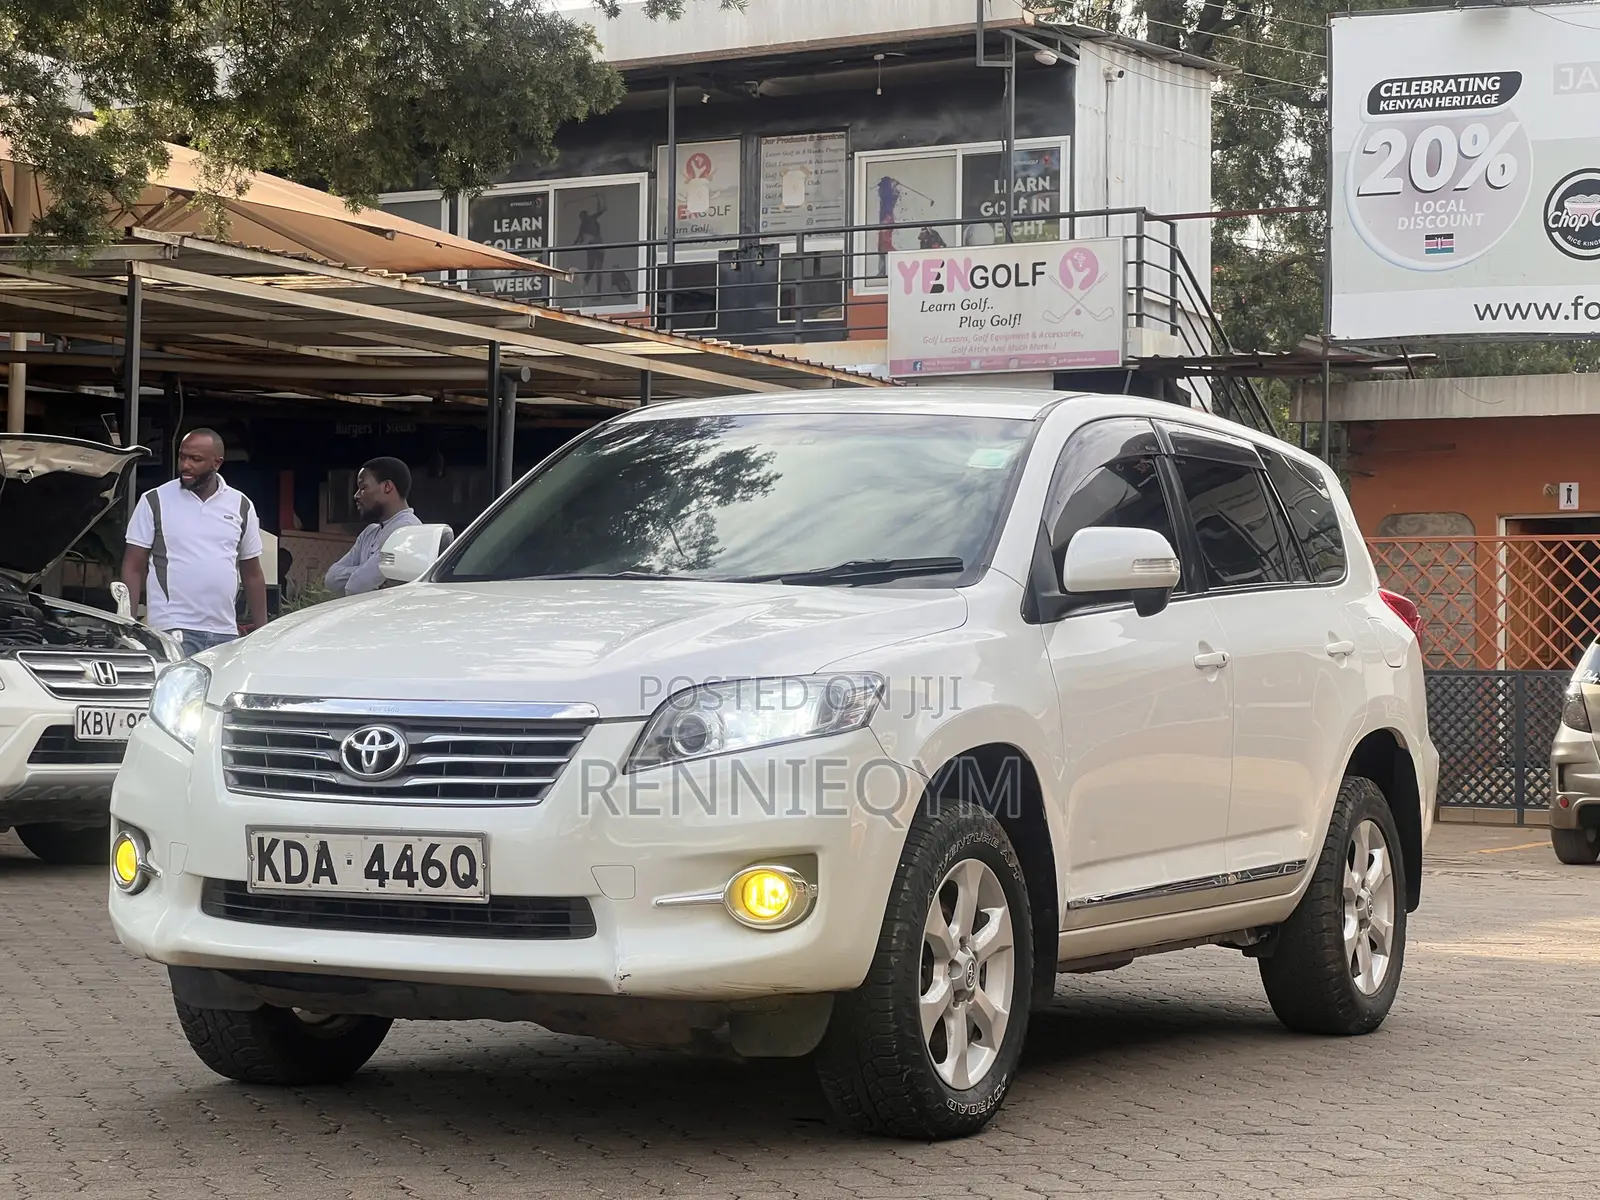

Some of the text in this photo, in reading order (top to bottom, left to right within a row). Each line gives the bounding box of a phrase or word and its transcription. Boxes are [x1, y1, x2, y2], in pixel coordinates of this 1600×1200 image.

[1379, 76, 1501, 98] CELEBRATING
[1379, 94, 1499, 111] KENYAN HERITAGE
[1356, 121, 1521, 197] 20%
[980, 197, 1050, 217] GOF IN
[1414, 199, 1467, 214] LOCAL
[493, 216, 542, 233] LEARN
[1397, 213, 1485, 230] DISCOUNT
[1548, 209, 1589, 232] Chop
[527, 236, 542, 249] IN
[1566, 234, 1582, 246] RICE
[897, 256, 1047, 295] YENGOLF
[493, 276, 542, 293] WEEKS
[920, 297, 994, 313] Learn Golf..
[959, 313, 1022, 330] Play Golf!
[922, 335, 939, 346] Golf
[973, 333, 989, 343] Golf
[990, 331, 1029, 342] Equipment
[1031, 331, 1037, 339] &
[951, 345, 967, 355] Golf
[81, 710, 116, 736] KBV
[257, 836, 479, 890] KDA 446Q
[946, 1073, 1008, 1115] JOYROAD
